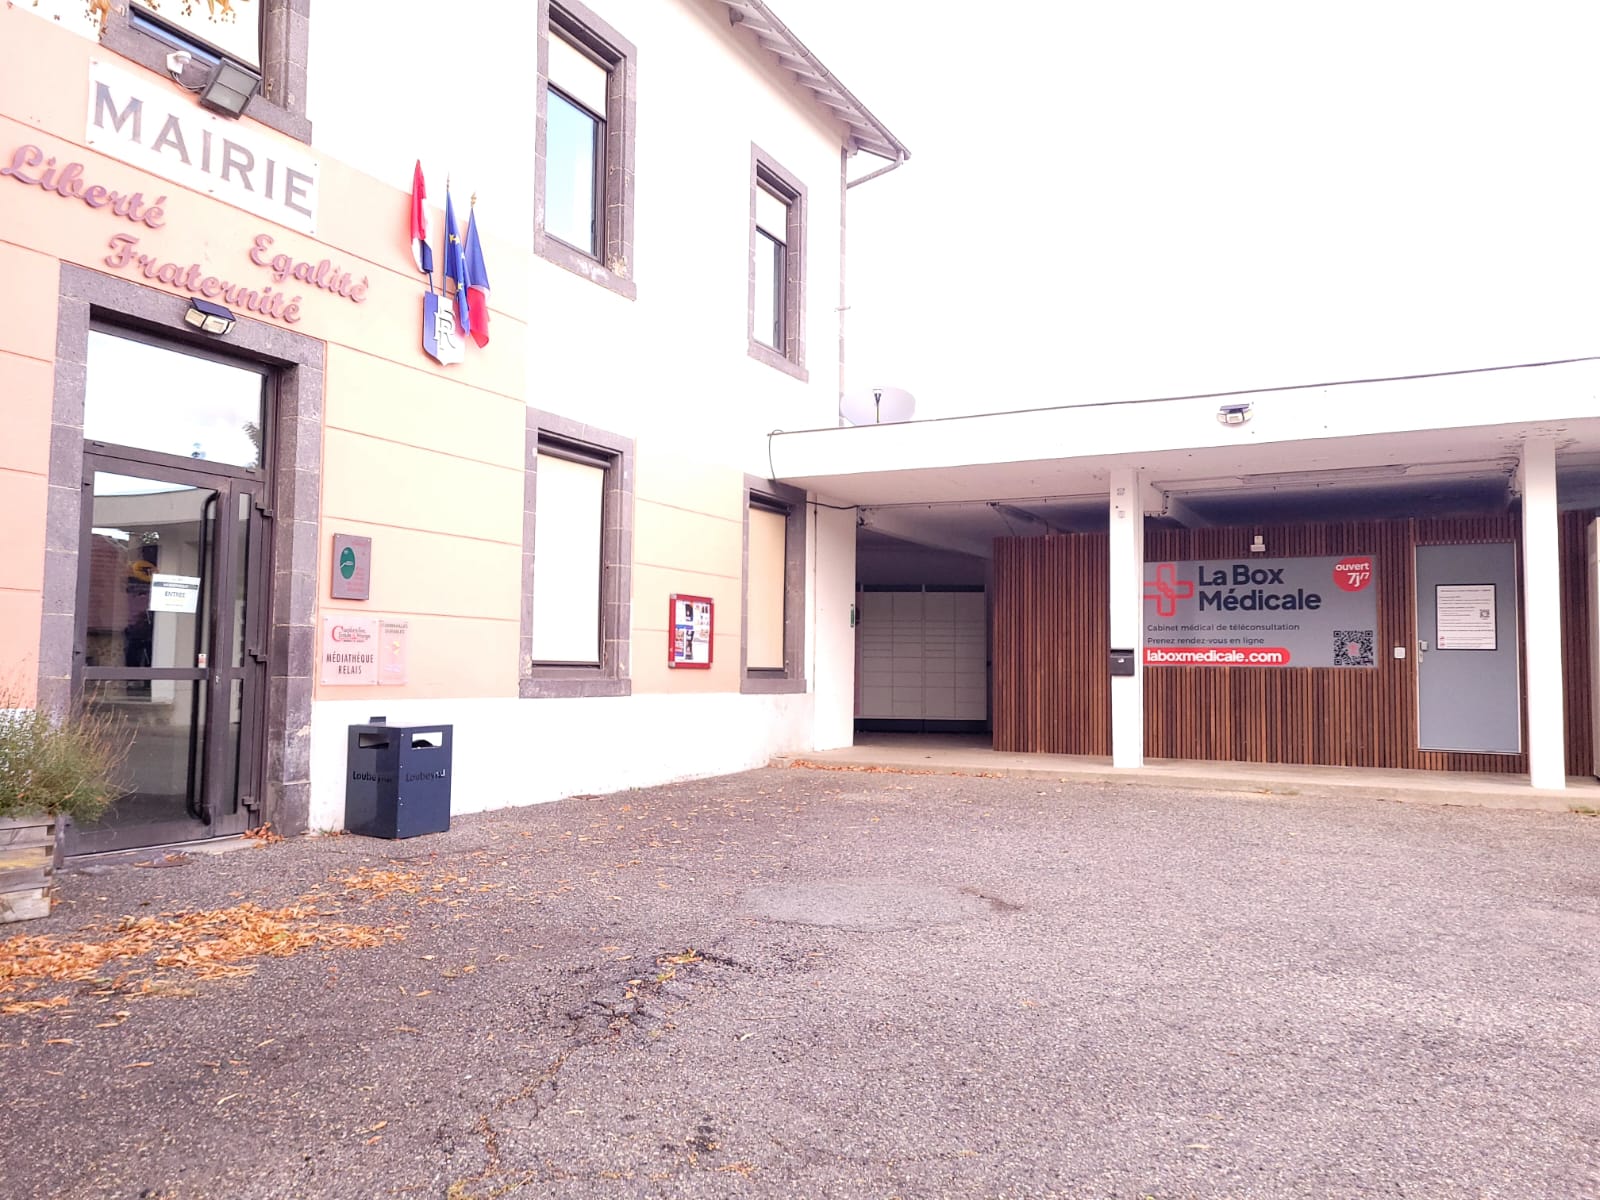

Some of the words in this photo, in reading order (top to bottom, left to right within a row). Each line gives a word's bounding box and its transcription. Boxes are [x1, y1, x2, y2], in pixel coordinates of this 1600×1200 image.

[93, 80, 314, 219] MAIRIE
[1, 144, 167, 229] Liberté
[105, 233, 303, 324] Fraternité
[1335, 562, 1370, 571] ouvert
[1198, 565, 1227, 586] La
[1232, 564, 1285, 586] Box
[1199, 588, 1322, 611] Médicale
[1147, 624, 1178, 632] Cabinet
[1181, 623, 1214, 631] médical
[1216, 623, 1227, 631] de
[1229, 623, 1300, 631] téléconsultation
[1147, 637, 1176, 645] Prenez
[1177, 637, 1228, 645] rendez-vous
[1243, 636, 1265, 646] ligne
[326, 650, 374, 663] MÉDIATHÈQUE
[1147, 649, 1283, 663] laboxmedicale.com
[338, 665, 362, 674] RELAIS
